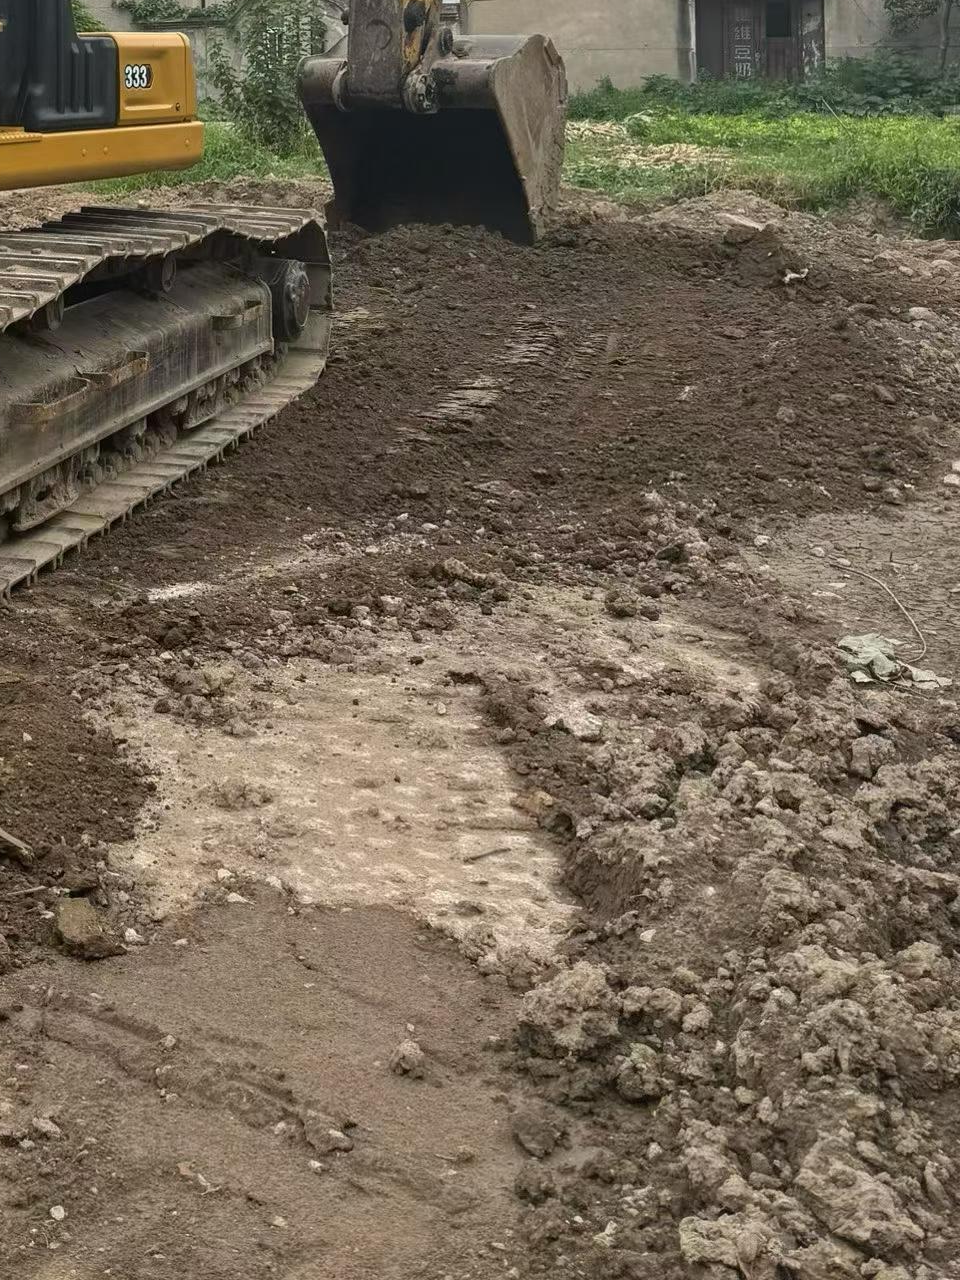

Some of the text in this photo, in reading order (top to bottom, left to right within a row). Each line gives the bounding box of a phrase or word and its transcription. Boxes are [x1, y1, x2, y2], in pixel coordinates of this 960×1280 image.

[733, 12, 752, 77] 维豆奶
[125, 65, 148, 88] 333
